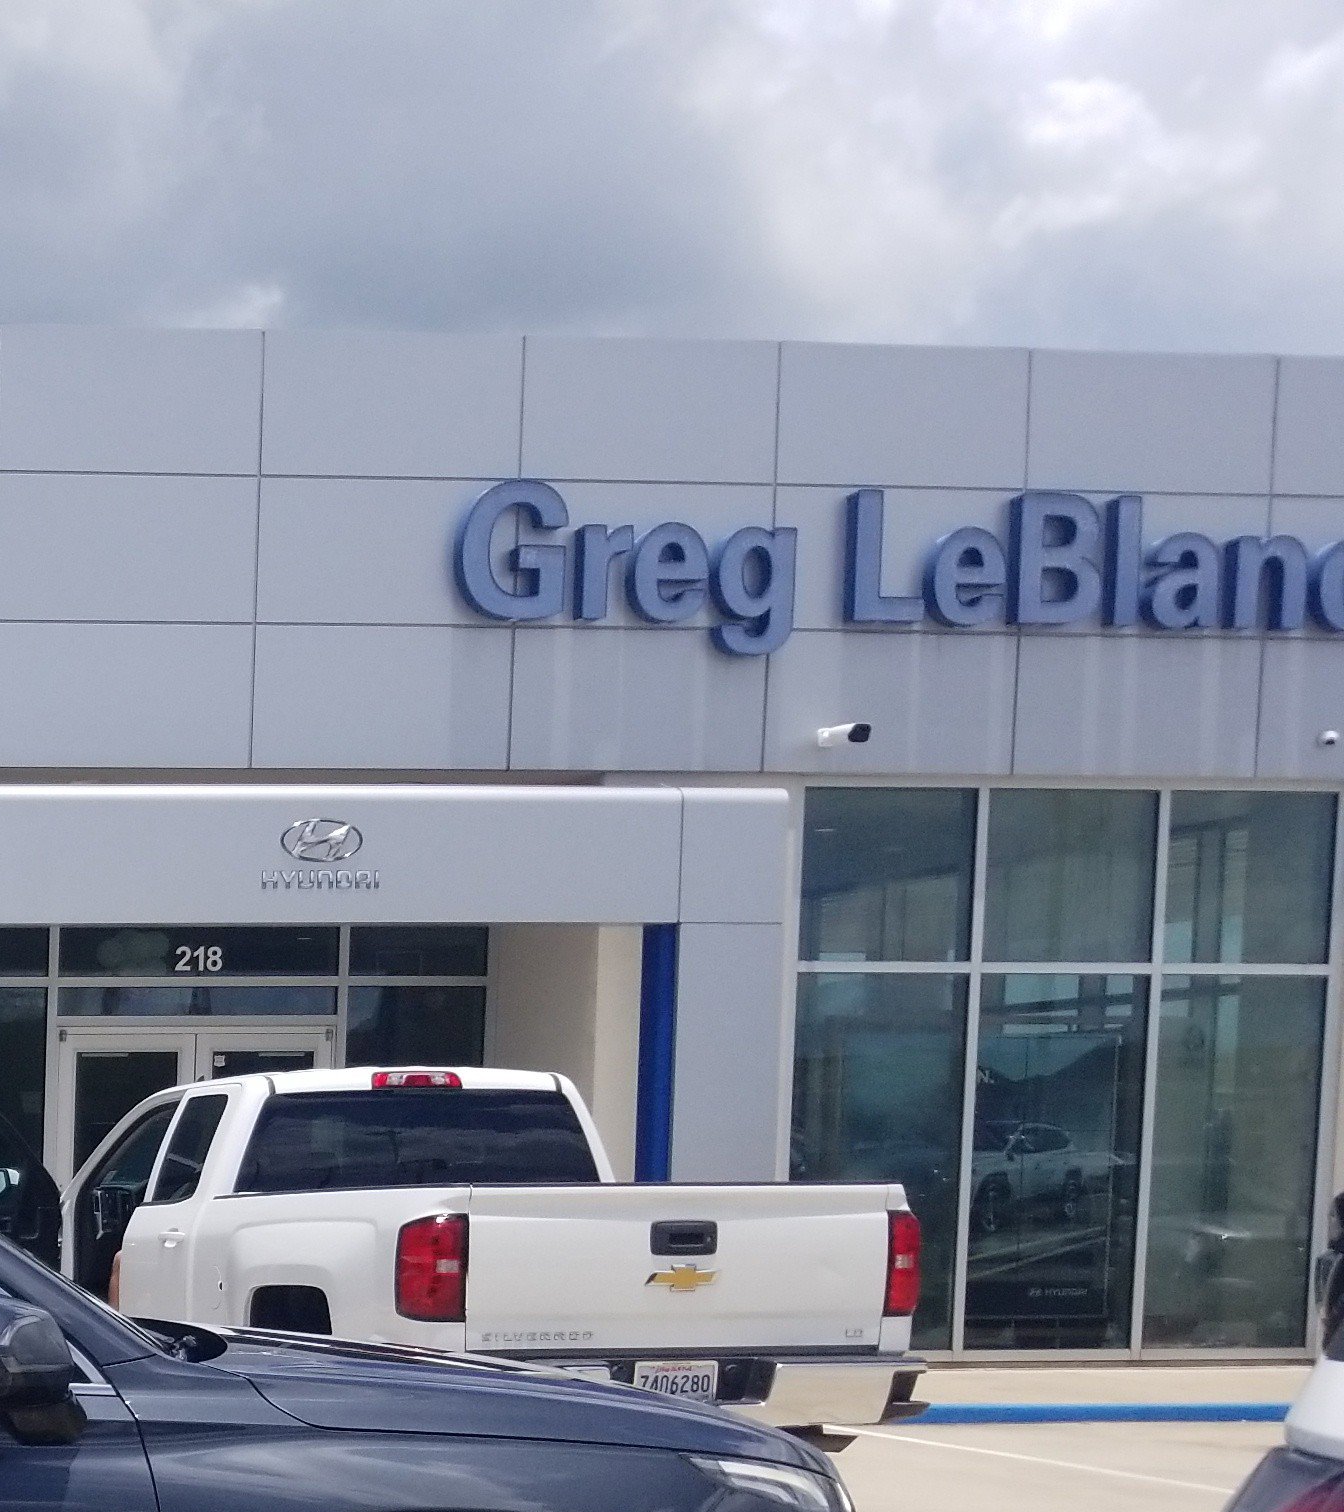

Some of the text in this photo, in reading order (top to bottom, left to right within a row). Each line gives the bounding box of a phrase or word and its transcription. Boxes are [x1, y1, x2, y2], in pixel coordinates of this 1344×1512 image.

[455, 479, 798, 656] Greg
[261, 869, 380, 890] HYUNDAI
[174, 945, 223, 972] 218
